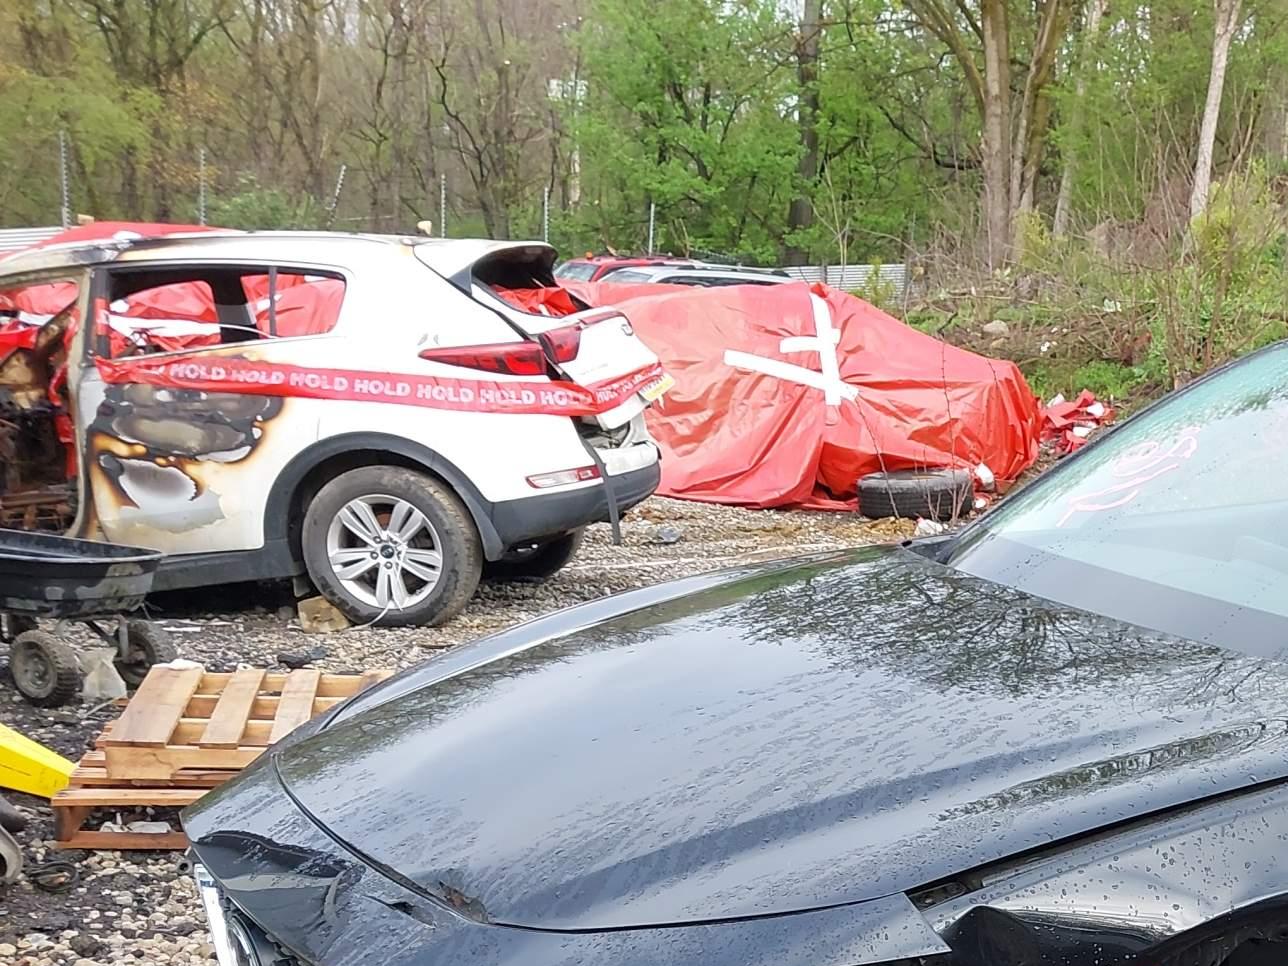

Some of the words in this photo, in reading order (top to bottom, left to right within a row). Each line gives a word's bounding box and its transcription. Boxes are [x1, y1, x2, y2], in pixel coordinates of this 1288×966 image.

[170, 363, 226, 380] HOLD
[231, 369, 286, 385] HOLD
[290, 374, 349, 391] HOLD
[353, 379, 411, 397] HOLD
[416, 383, 474, 403] HOLD
[479, 387, 536, 405] HOLD
